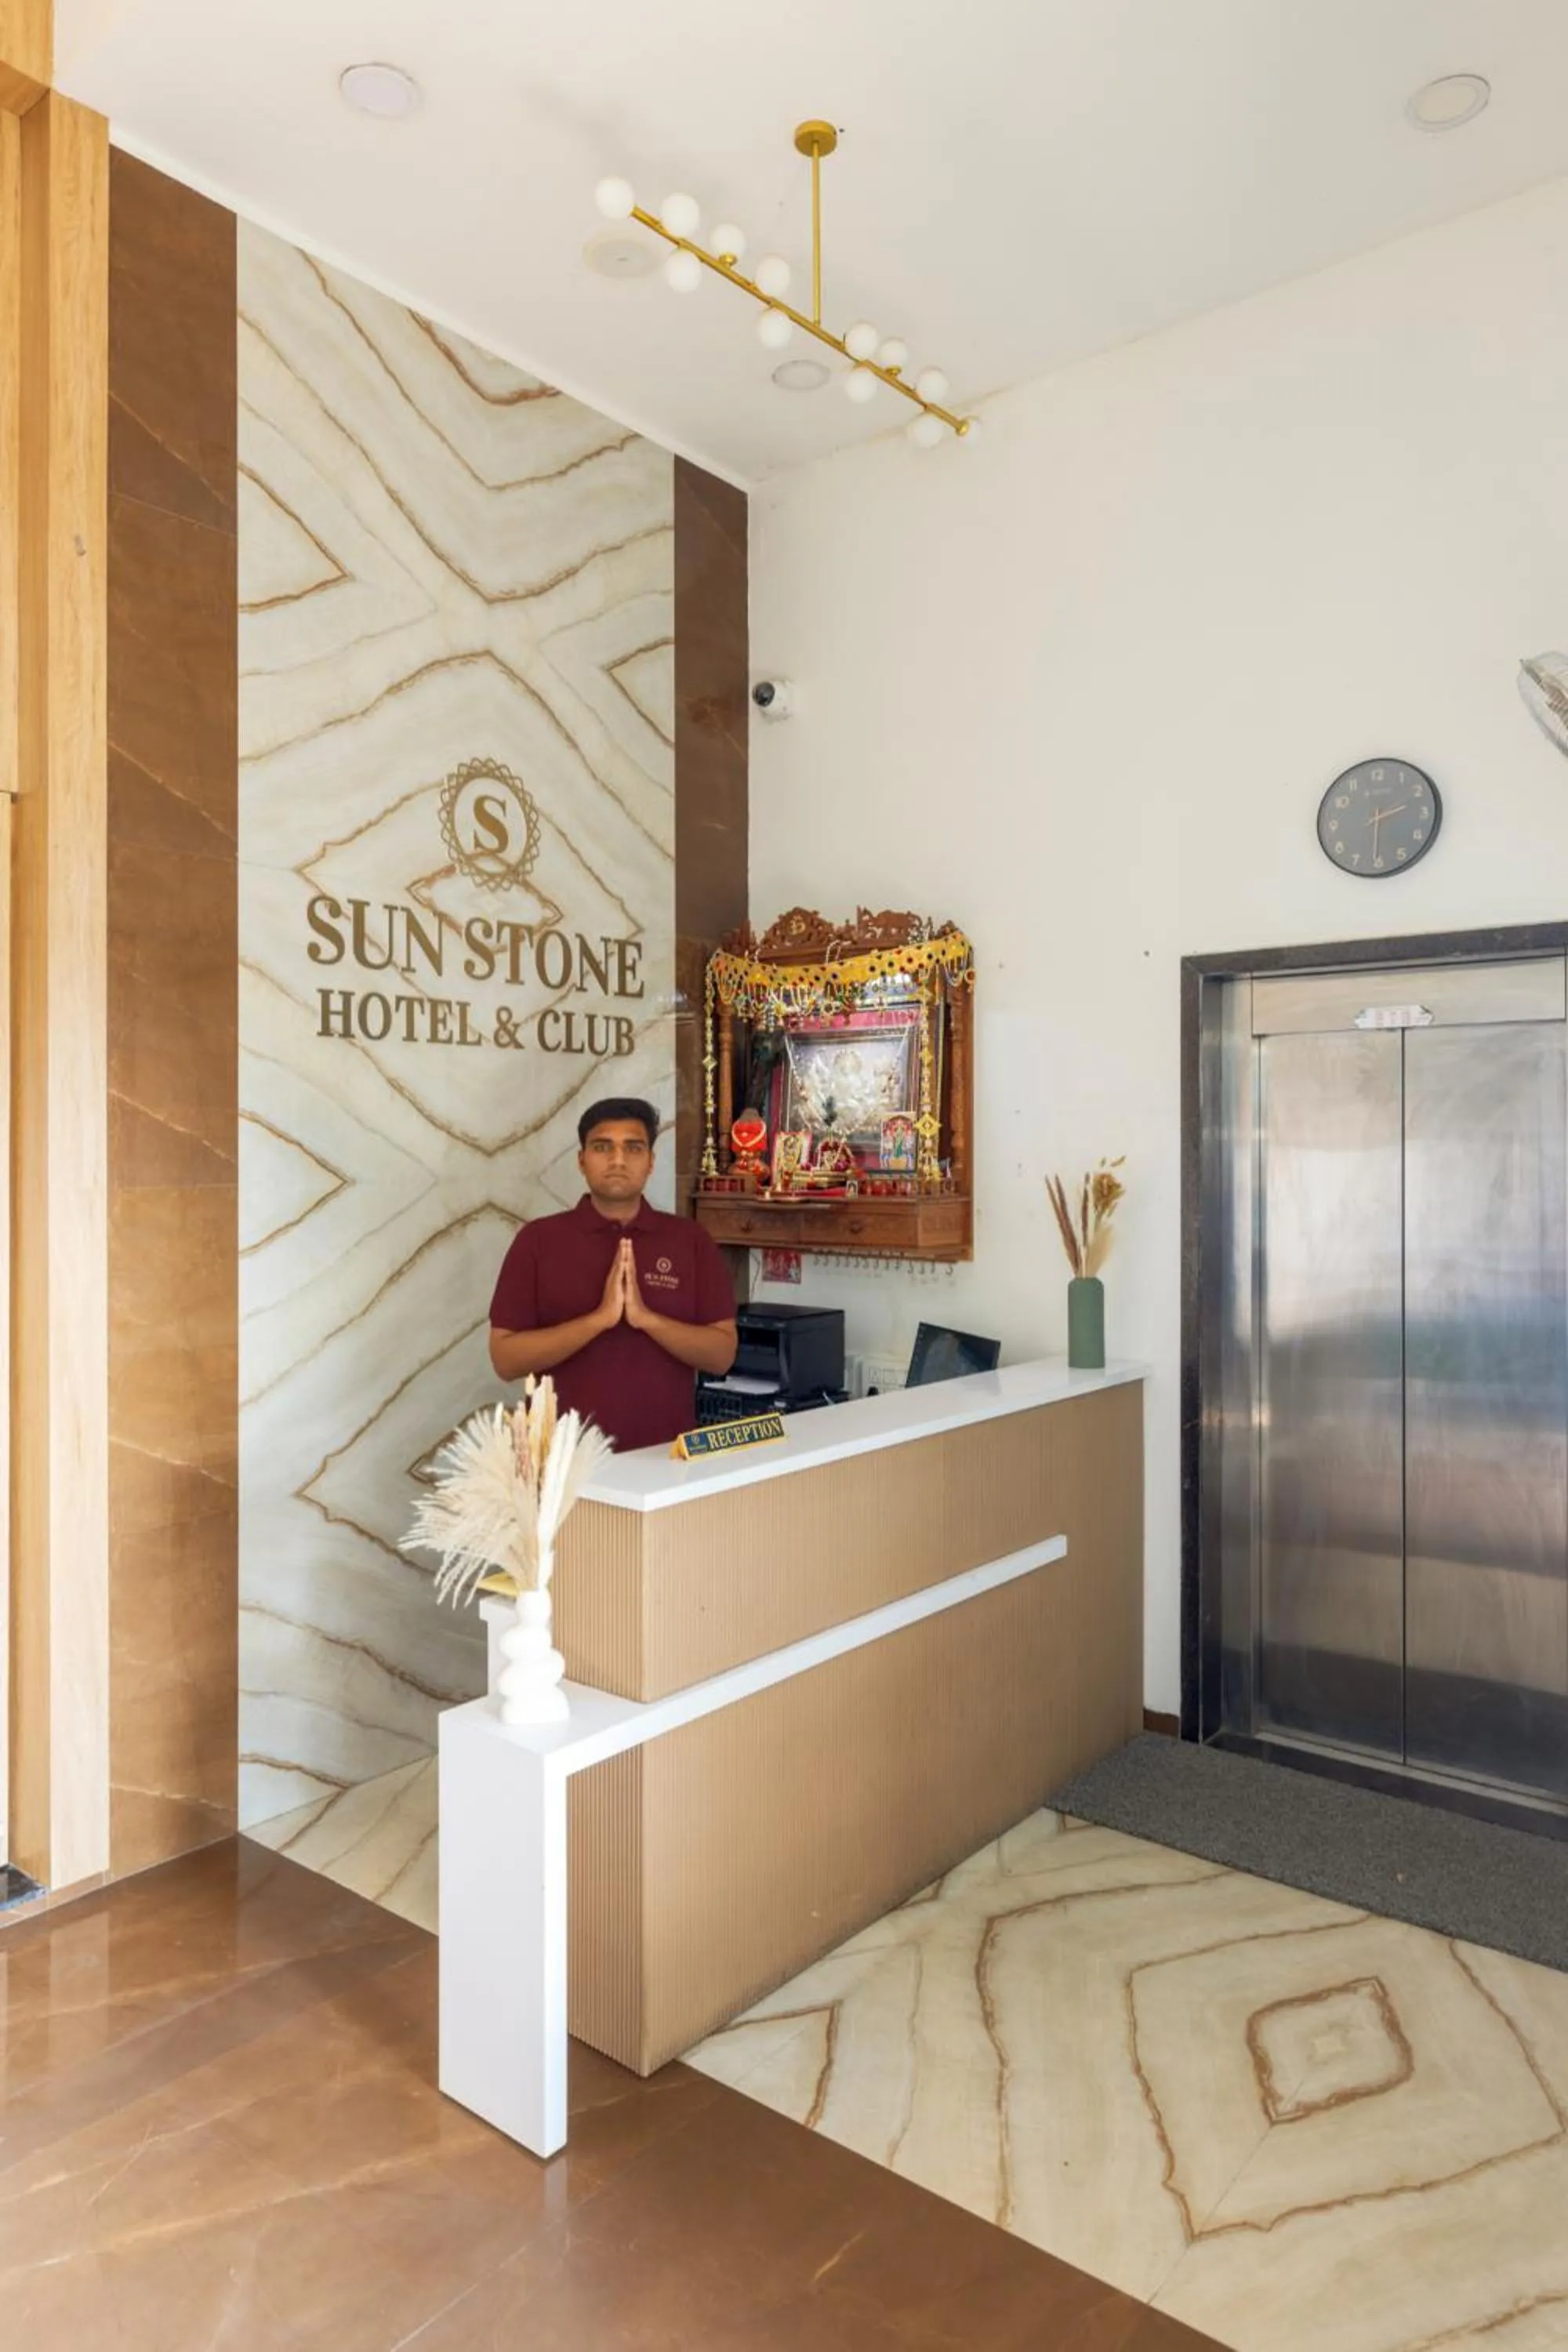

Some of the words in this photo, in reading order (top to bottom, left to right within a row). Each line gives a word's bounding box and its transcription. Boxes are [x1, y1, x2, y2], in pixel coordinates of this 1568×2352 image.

[1372, 768, 1384, 781] 12
[1399, 771, 1404, 783] 1
[1348, 777, 1358, 792] 11
[1414, 785, 1423, 797] 2
[1419, 806, 1428, 819] 3
[473, 794, 510, 855] S
[1413, 829, 1423, 840] 4
[1352, 853, 1360, 866] 7
[1396, 848, 1406, 861] 5
[307, 895, 448, 977] SUN
[463, 917, 644, 999] STONE
[316, 988, 482, 1047] HOTEL
[493, 1005, 525, 1050] &
[537, 1008, 636, 1056] CLUB
[707, 1419, 782, 1449] RECEPTION
